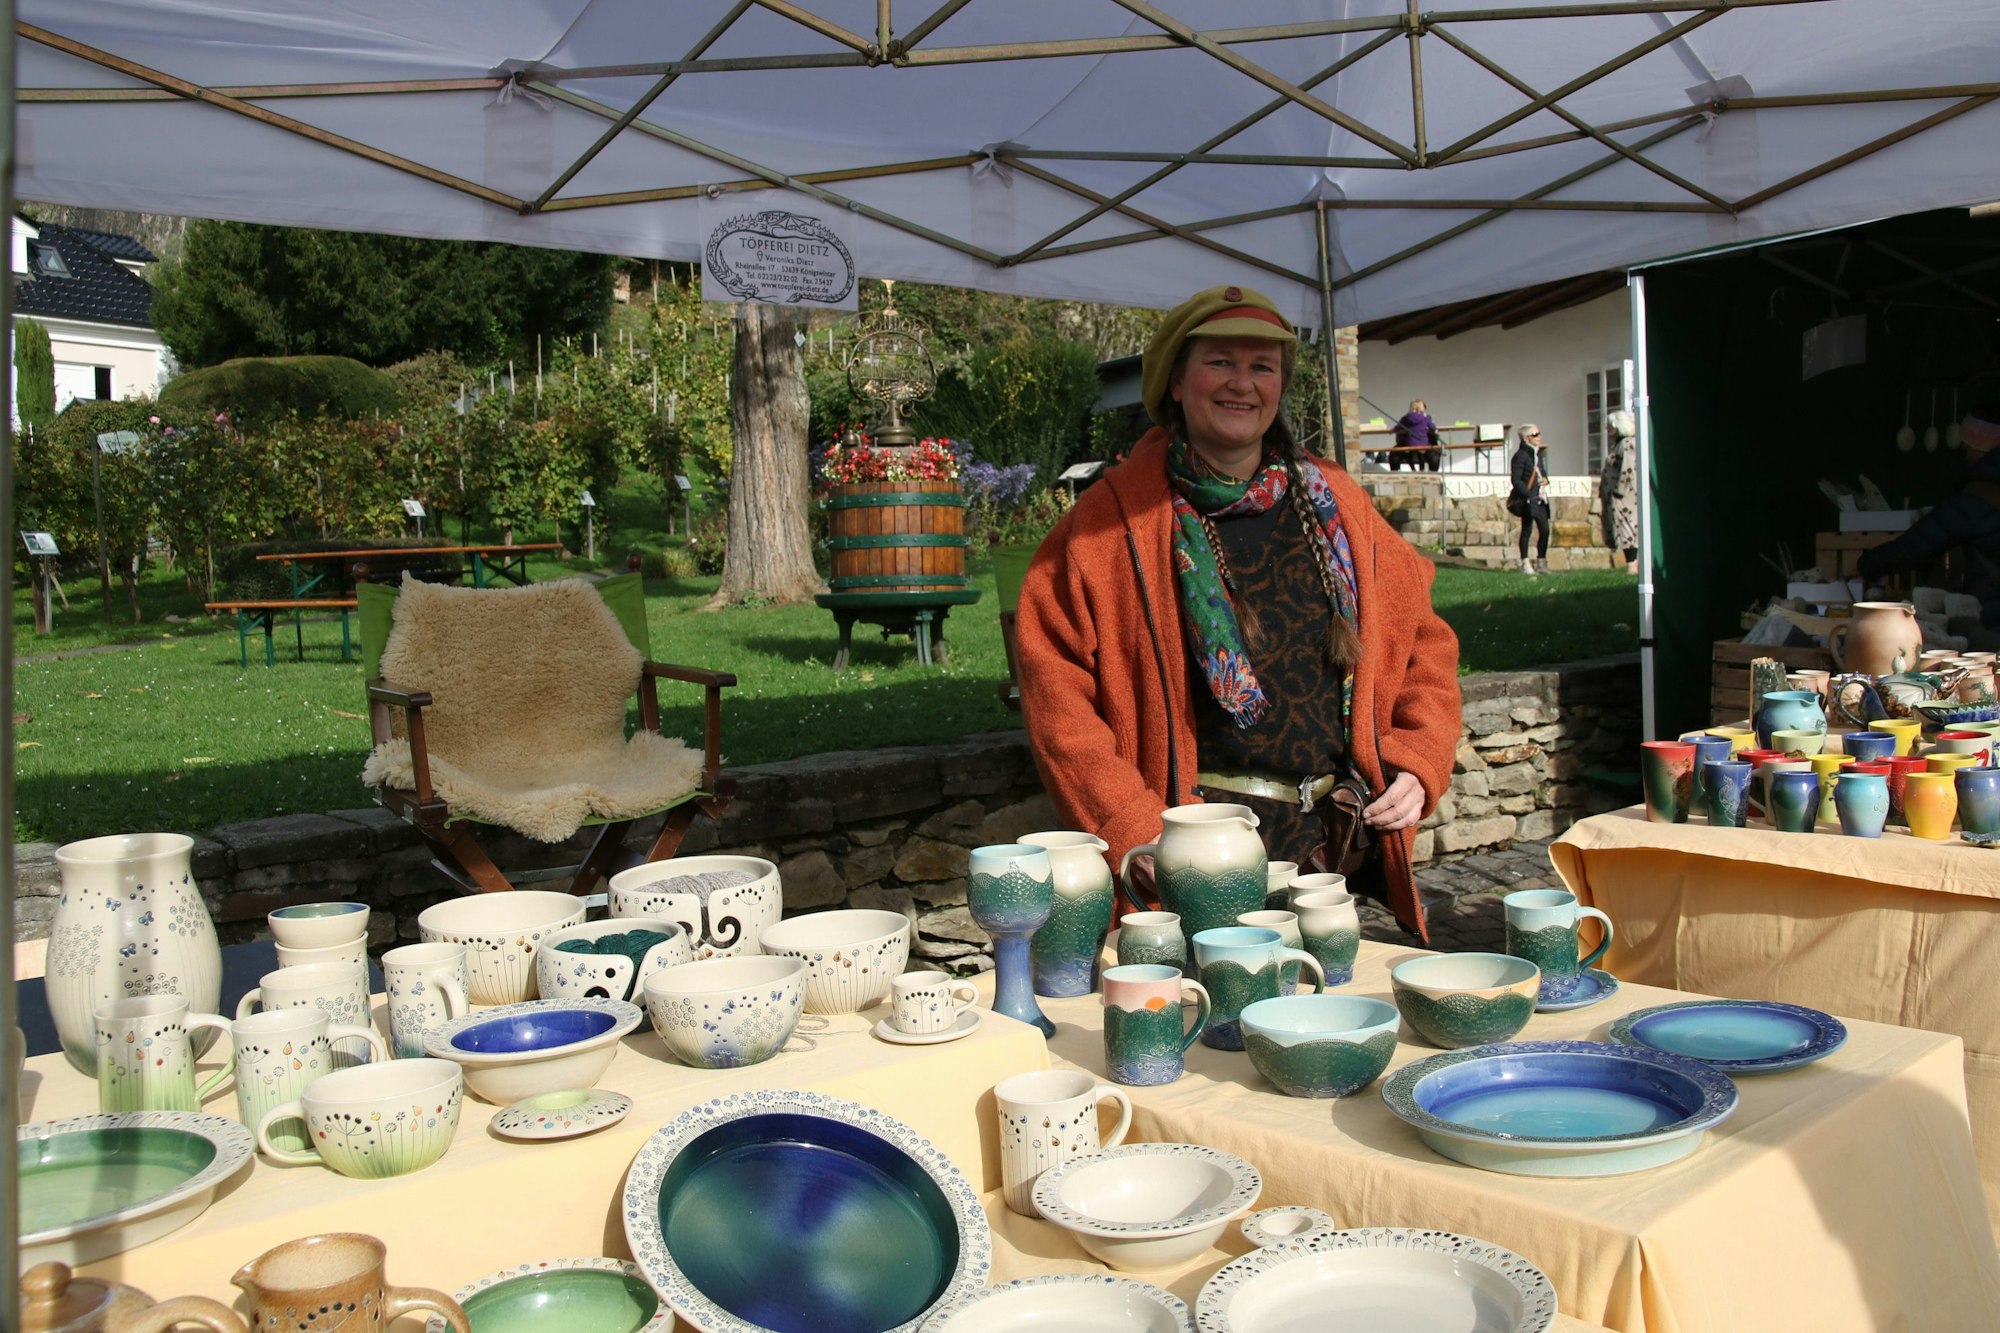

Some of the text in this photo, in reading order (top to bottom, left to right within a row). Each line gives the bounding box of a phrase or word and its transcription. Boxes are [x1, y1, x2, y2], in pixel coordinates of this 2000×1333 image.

[739, 237, 829, 256] TÖPFEREI DIETZ
[765, 254, 814, 266] Veronika Dietz
[736, 262, 766, 271] Rheinallee
[782, 266, 799, 274] 53639
[800, 268, 836, 278] Königswinter
[761, 282, 829, 294] www.toepferei-dietz.de
